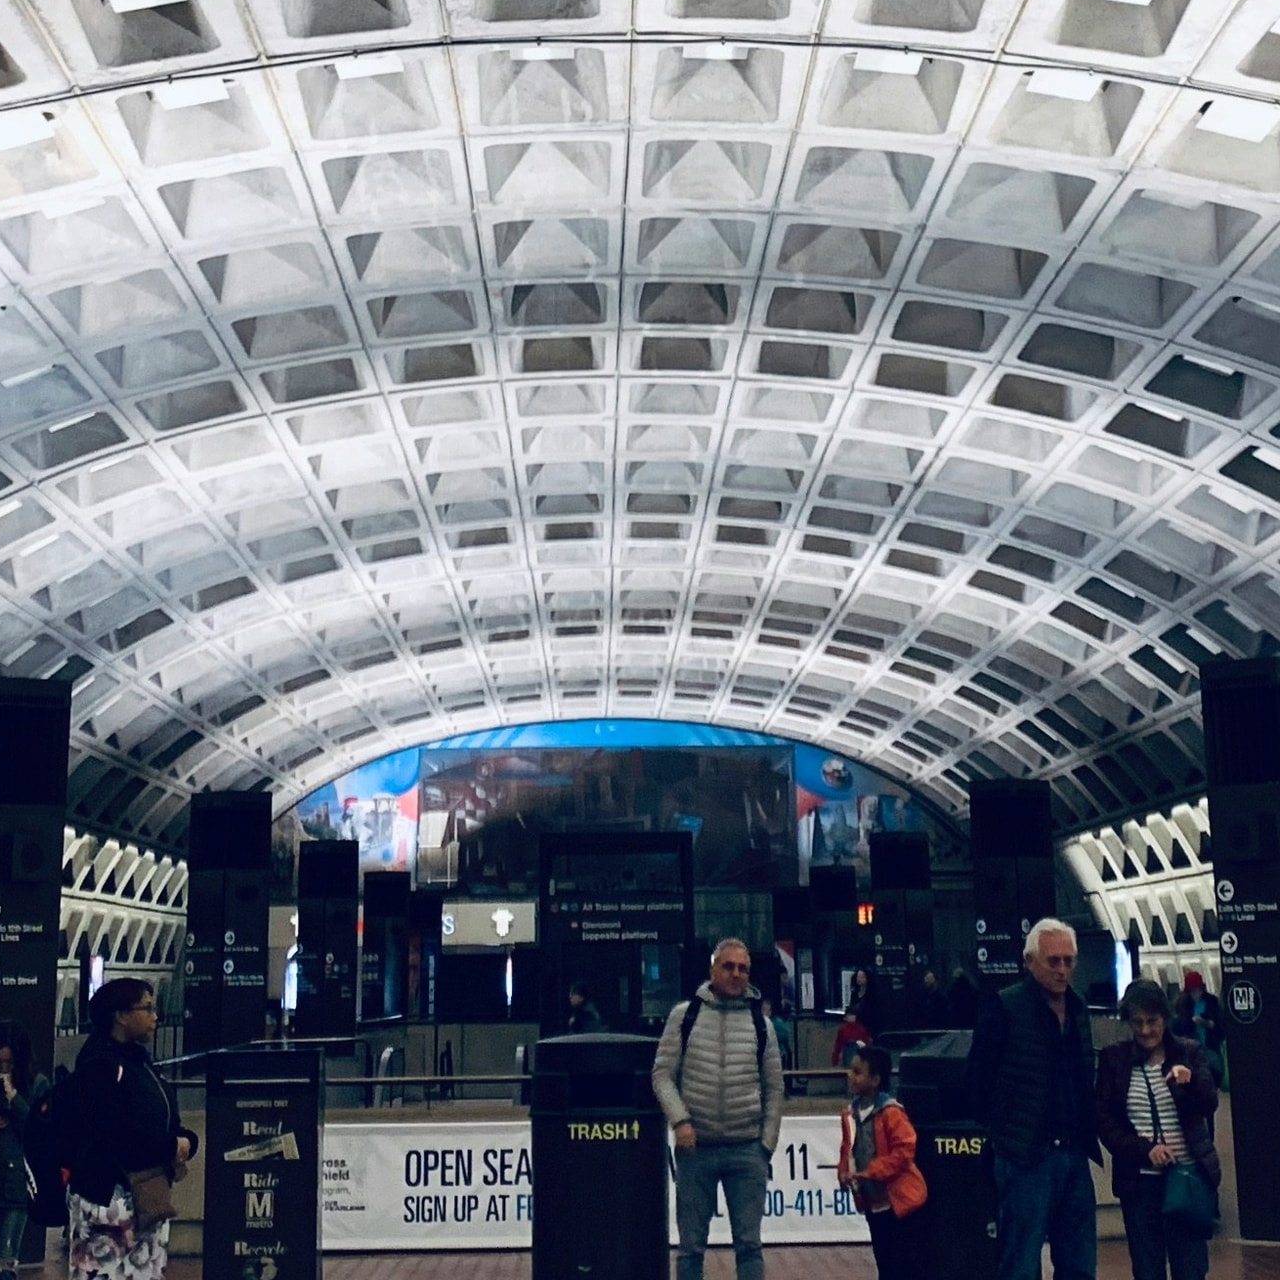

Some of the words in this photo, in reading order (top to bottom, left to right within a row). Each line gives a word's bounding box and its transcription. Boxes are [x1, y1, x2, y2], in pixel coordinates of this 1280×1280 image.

[568, 1123, 628, 1140] TRASH
[934, 1137, 987, 1155] TRAS
[404, 1149, 473, 1187] OPEN
[482, 1148, 533, 1186] SEA
[785, 1143, 809, 1181] 11
[403, 1195, 447, 1223] SIGN
[453, 1195, 479, 1223] UP
[485, 1194, 511, 1222] AT
